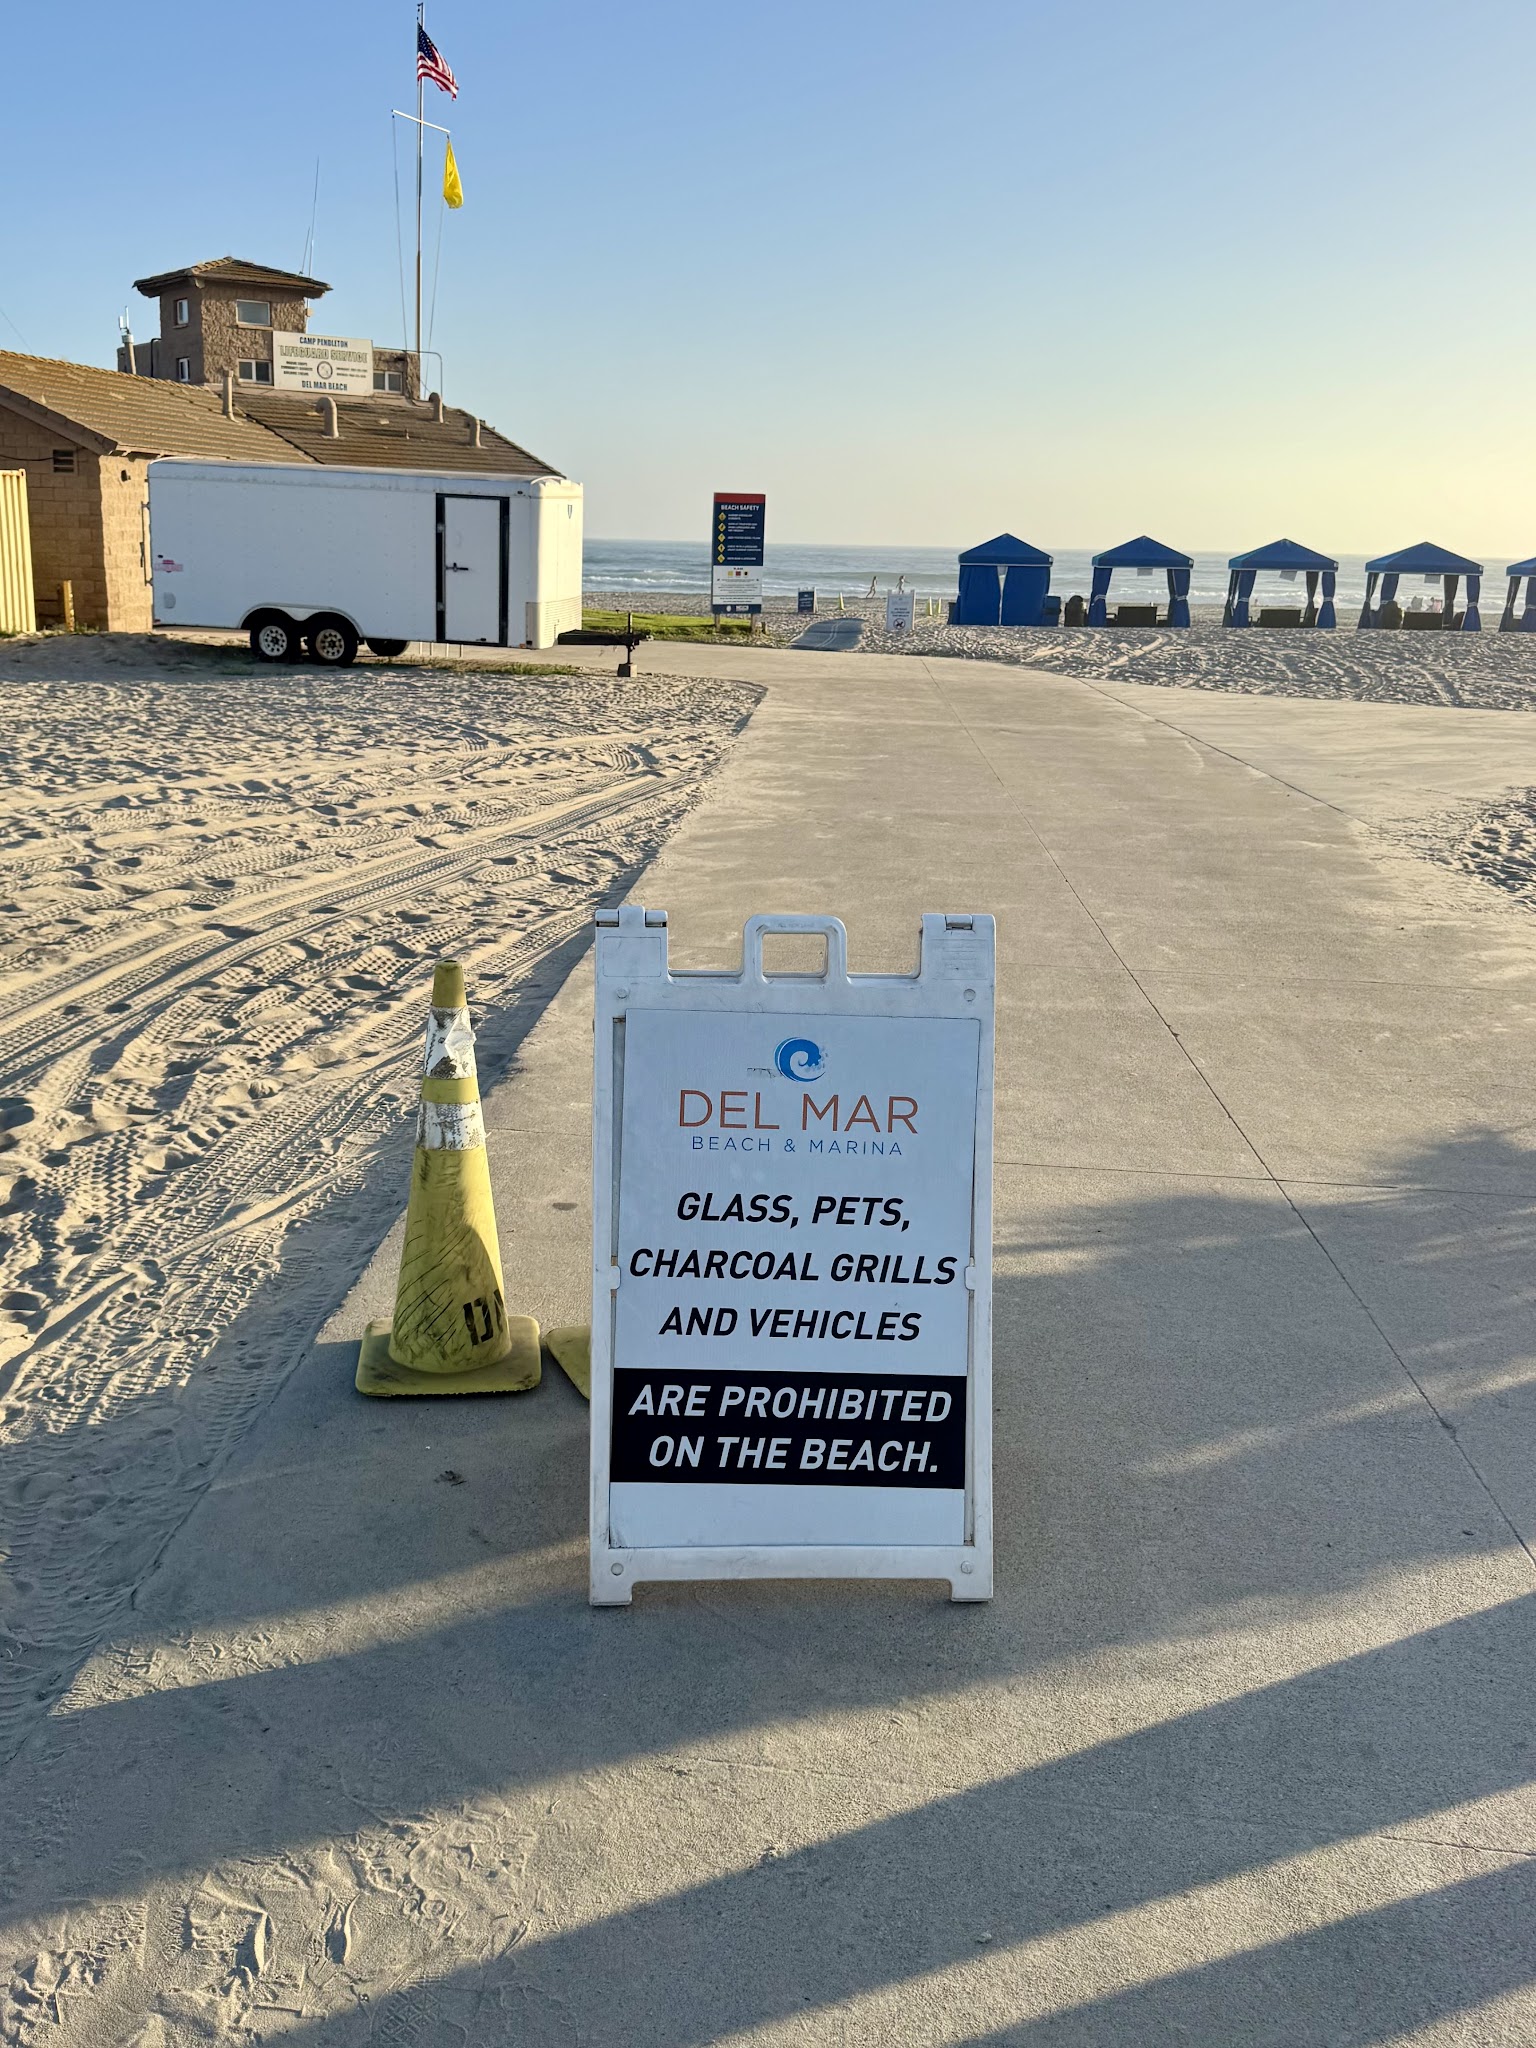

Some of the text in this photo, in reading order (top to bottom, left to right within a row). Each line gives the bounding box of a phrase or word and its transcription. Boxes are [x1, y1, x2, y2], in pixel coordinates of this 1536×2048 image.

[279, 345, 368, 363] LIFEGUARD SERVICE
[299, 336, 348, 348] CAMP PENDLETON
[301, 380, 348, 391] DEL MAR BEACH
[678, 1088, 919, 1135] DEL MAR
[692, 1135, 903, 1156] BEACH & MARINA
[677, 1192, 910, 1233] GLASS, PETS,
[629, 1248, 958, 1285] CHARCOAL GRILLS
[658, 1306, 922, 1341] AND VEHICLES
[627, 1384, 952, 1422] ARE PROHIBITED
[649, 1435, 938, 1473] ON THE BEACH.
